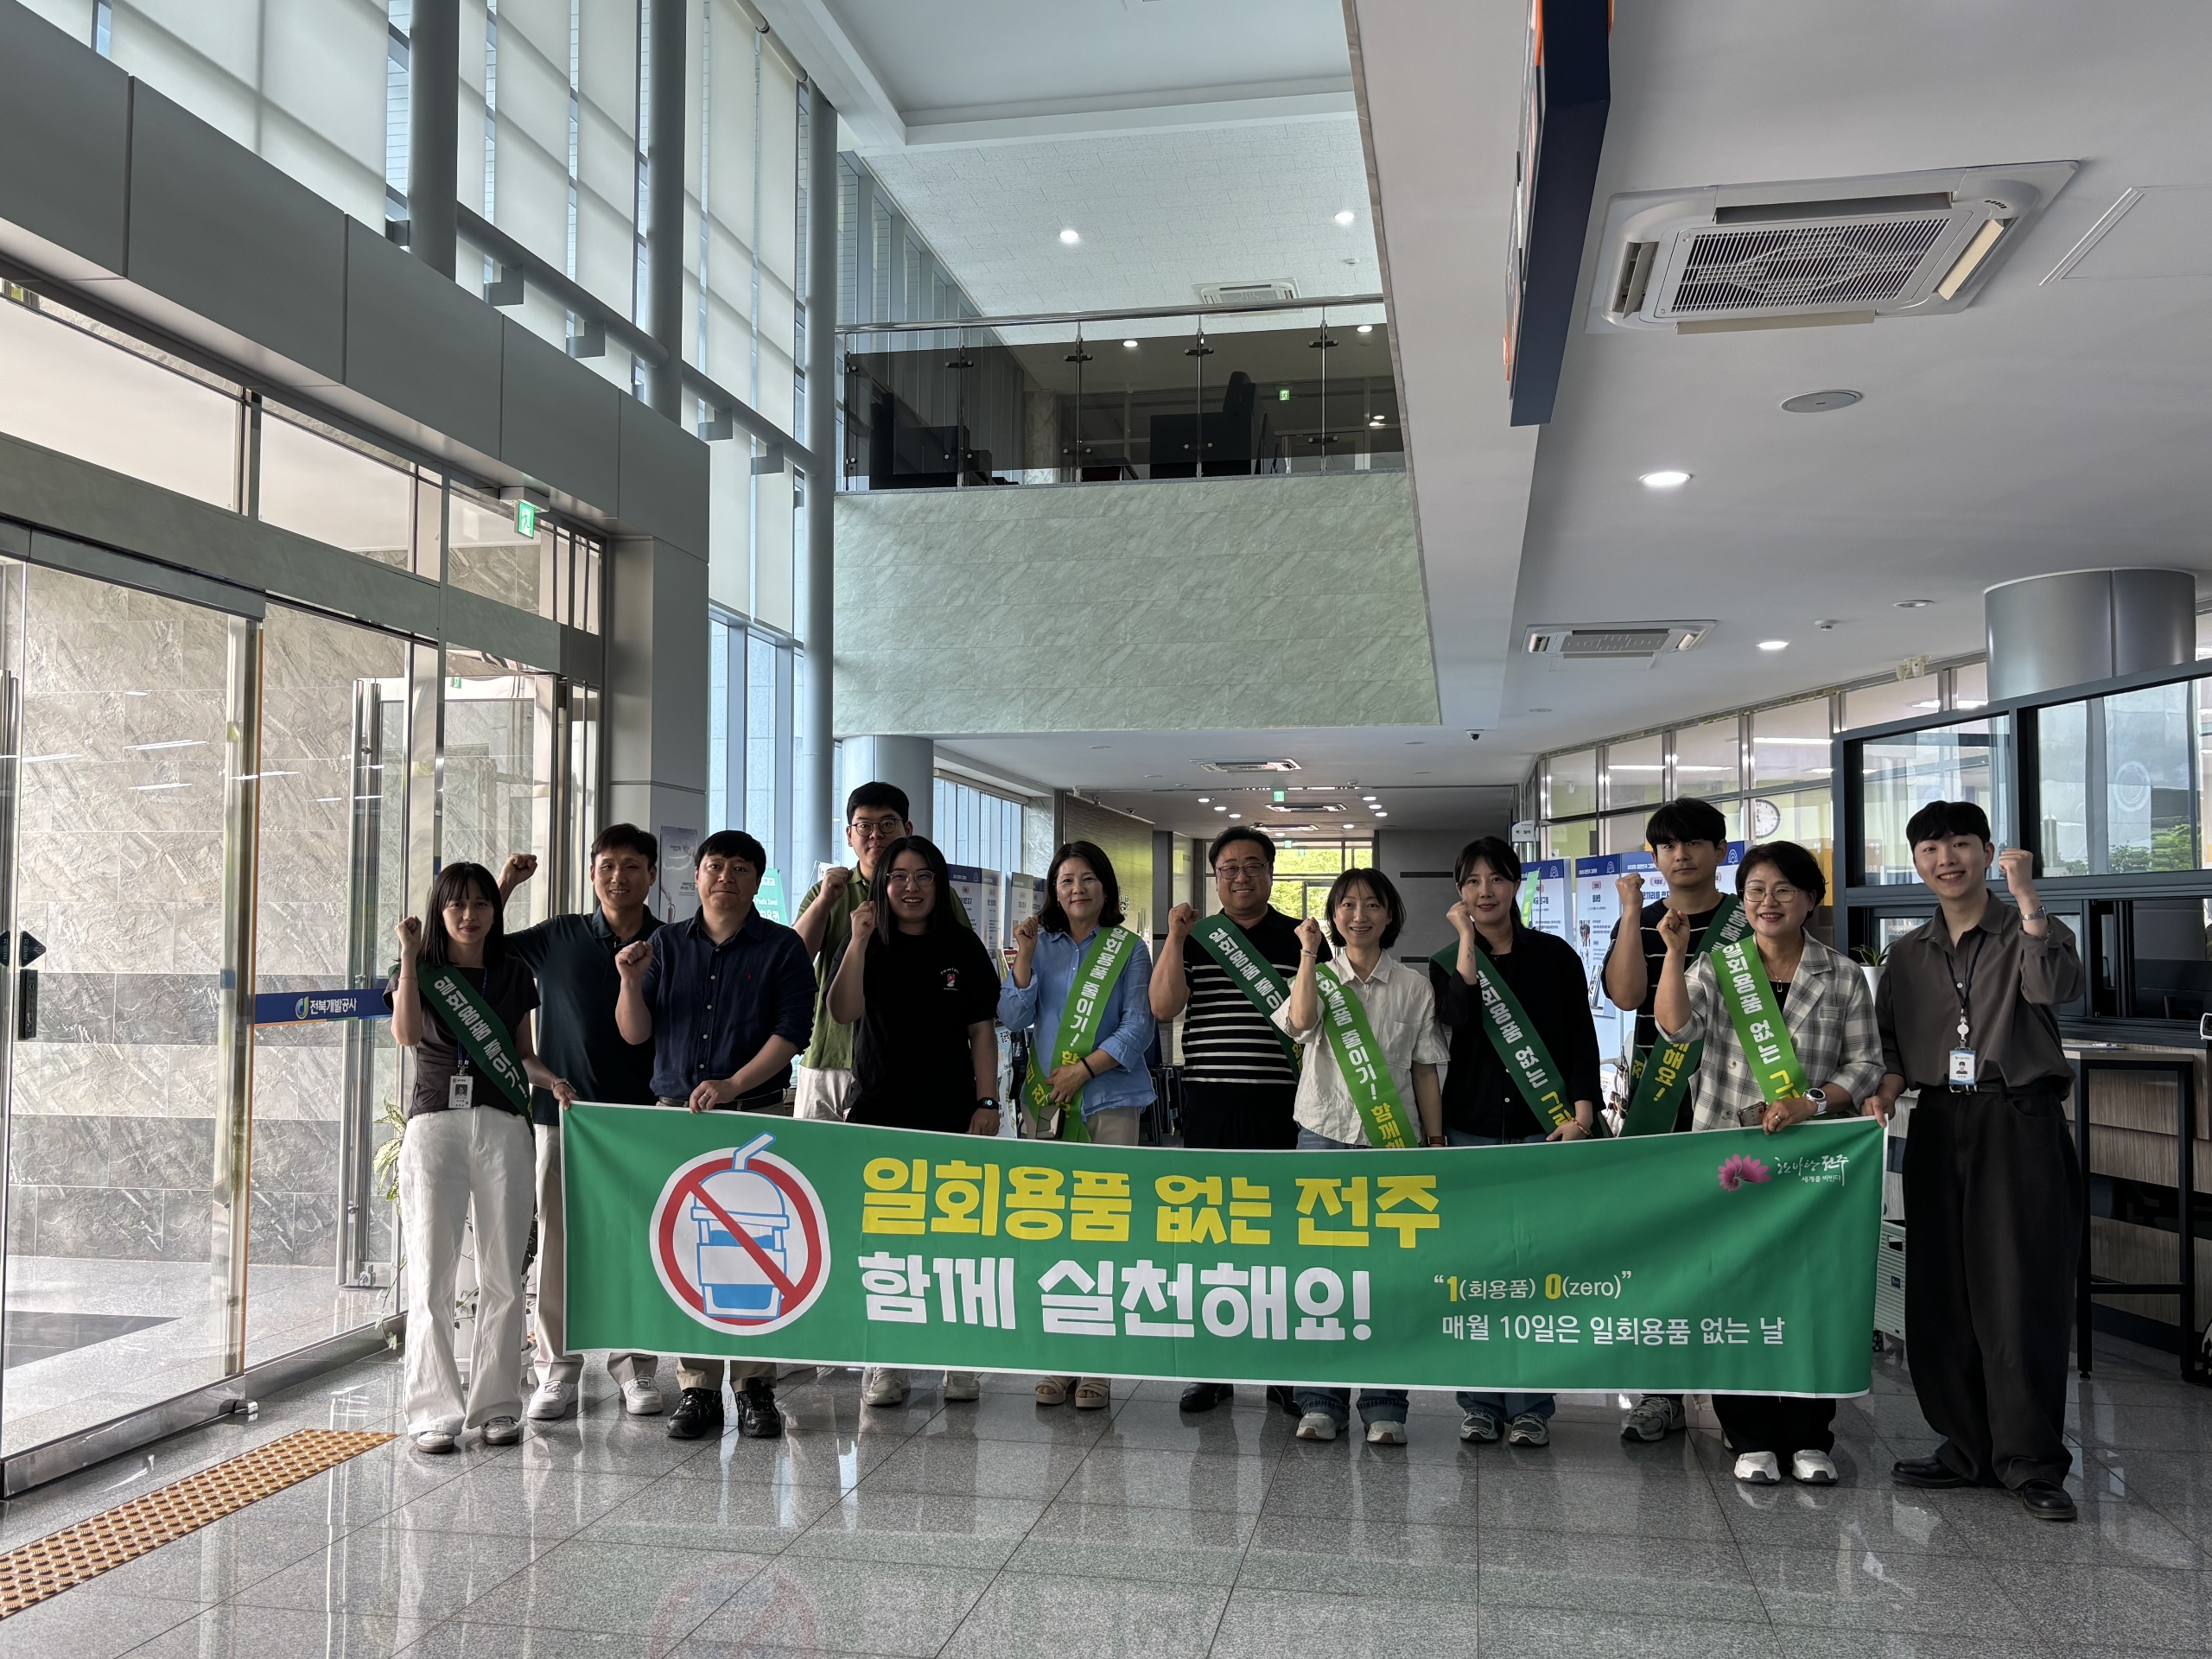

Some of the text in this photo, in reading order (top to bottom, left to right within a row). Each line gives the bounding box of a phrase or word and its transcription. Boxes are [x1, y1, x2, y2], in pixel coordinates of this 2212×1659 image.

[1090, 927, 1128, 980] 일회용품
[1208, 927, 1261, 981] 일회용품
[309, 997, 358, 1015] 전북개발공사
[1070, 981, 1100, 1047] 줄이기!
[1722, 942, 1764, 1015] 일회용품
[1750, 1019, 1781, 1065] 없는
[434, 976, 528, 1098] 일회용품 줄이기!
[1340, 1028, 1377, 1100] 줄이기!
[1515, 1046, 1548, 1089] 없는
[1821, 1154, 1850, 1186] 전주
[862, 1157, 1440, 1249] 일회용품 없는 전주
[858, 1251, 1372, 1340] 함께 실천해요!
[1442, 1314, 1786, 1346] 매월 10일은 일회용품 없는 날
